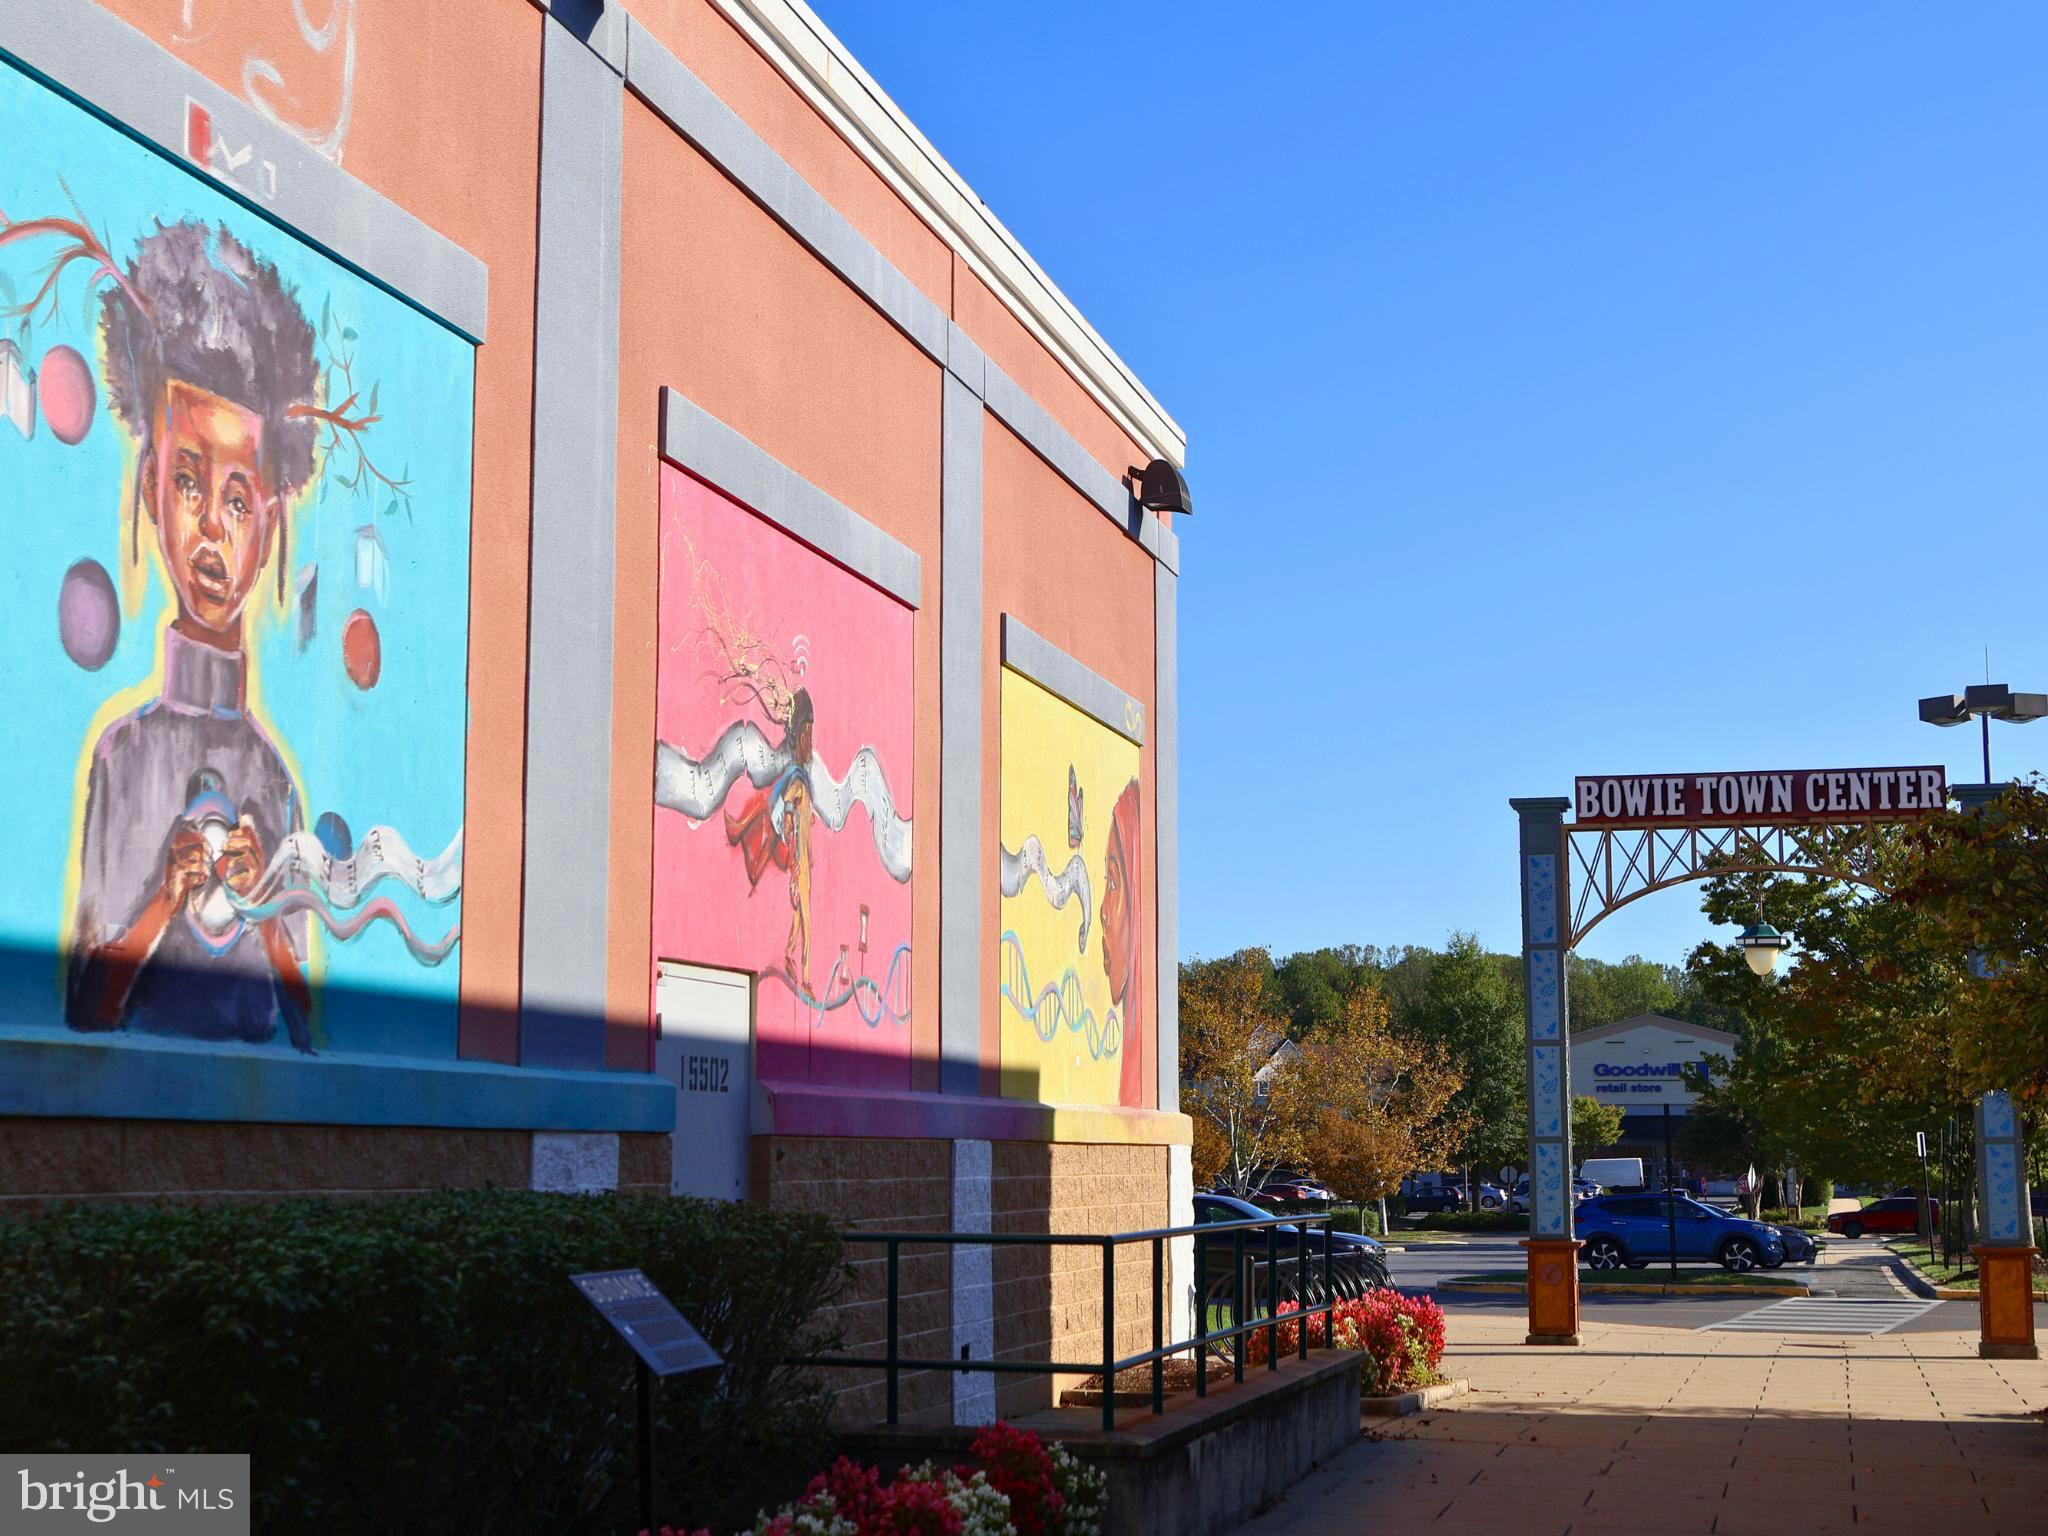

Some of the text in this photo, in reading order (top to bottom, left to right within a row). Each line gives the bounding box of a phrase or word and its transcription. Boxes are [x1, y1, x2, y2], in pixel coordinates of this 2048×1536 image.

[1577, 769, 1944, 818] BOWIE TOWN CENTER
[680, 1054, 729, 1093] 15502
[1593, 1062, 1681, 1077] Goodwill
[1596, 1083, 1662, 1093] retail store
